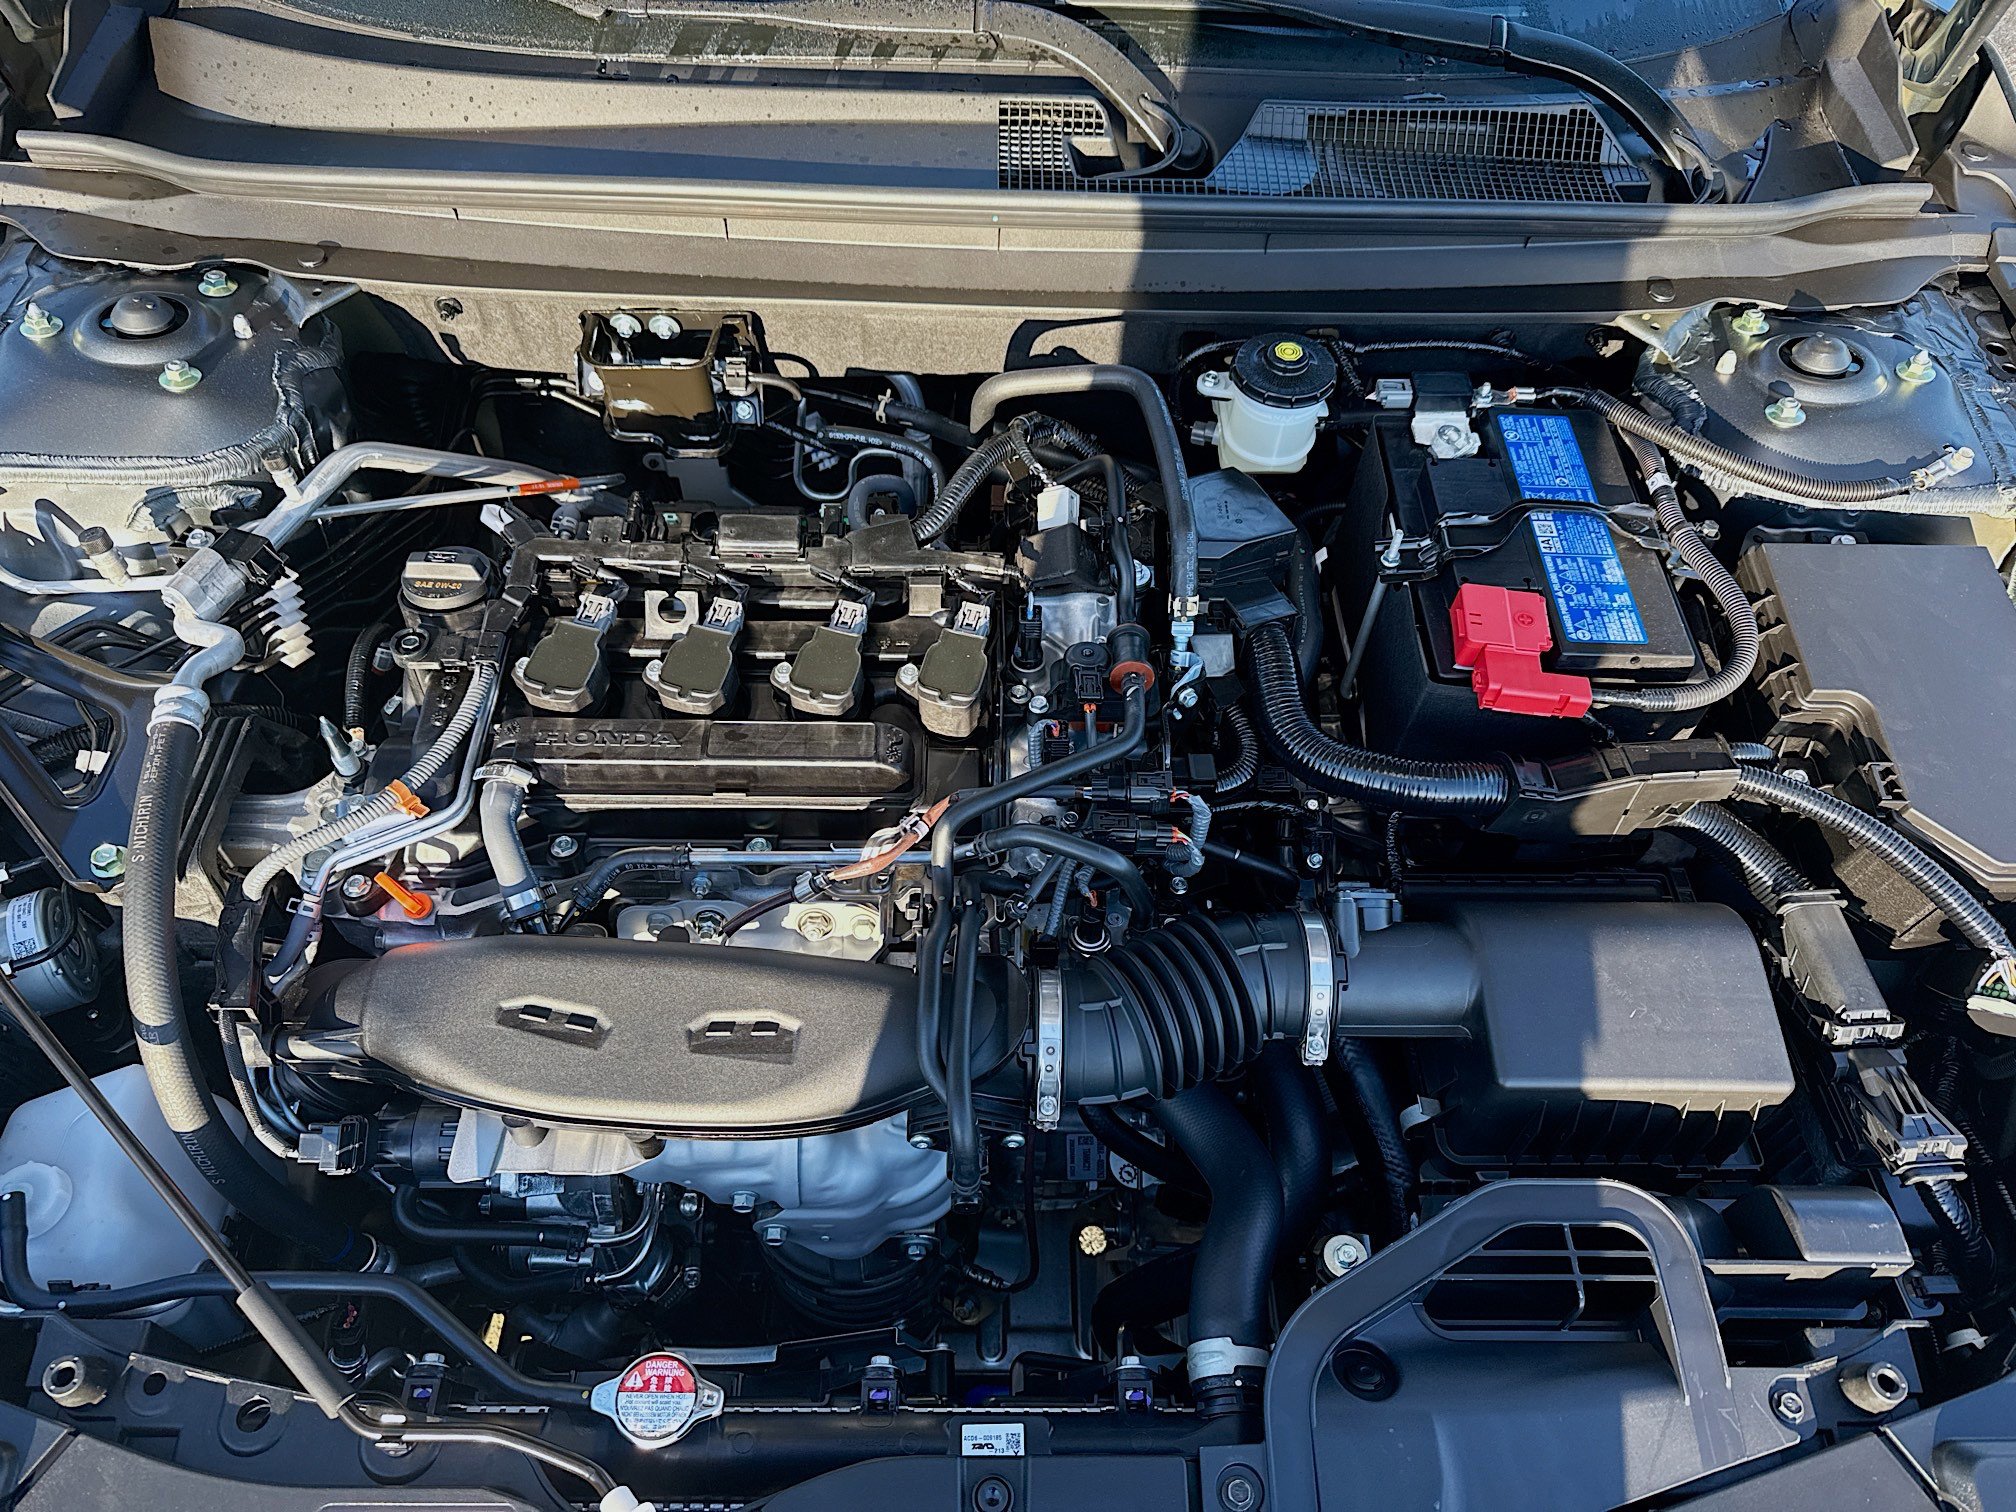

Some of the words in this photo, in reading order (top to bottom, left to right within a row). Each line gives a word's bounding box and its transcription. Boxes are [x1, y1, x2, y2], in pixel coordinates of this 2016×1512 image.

[1540, 538, 1553, 552] 4A
[414, 580, 434, 588] SAE
[435, 581, 463, 590] 0W-20
[534, 729, 682, 748] HONDA
[645, 1360, 679, 1369] DANGER
[645, 1368, 685, 1377] WARNUNG
